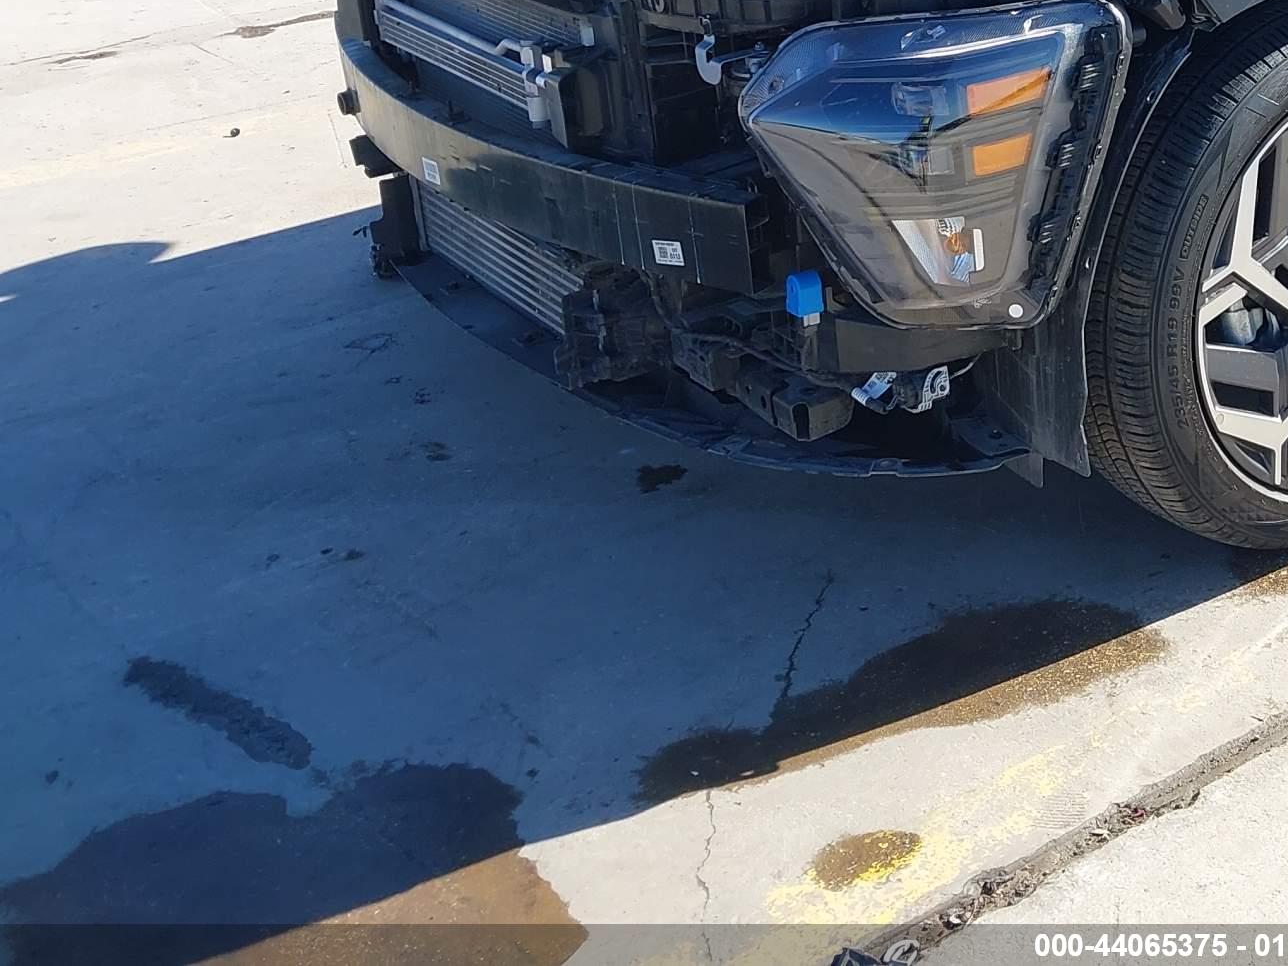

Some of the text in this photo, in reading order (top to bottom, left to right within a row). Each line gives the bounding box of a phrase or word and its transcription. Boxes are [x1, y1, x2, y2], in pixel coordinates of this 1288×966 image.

[1181, 194, 1209, 261] OUTSIDE
[1168, 265, 1186, 312] 99V
[1166, 317, 1178, 359] R19
